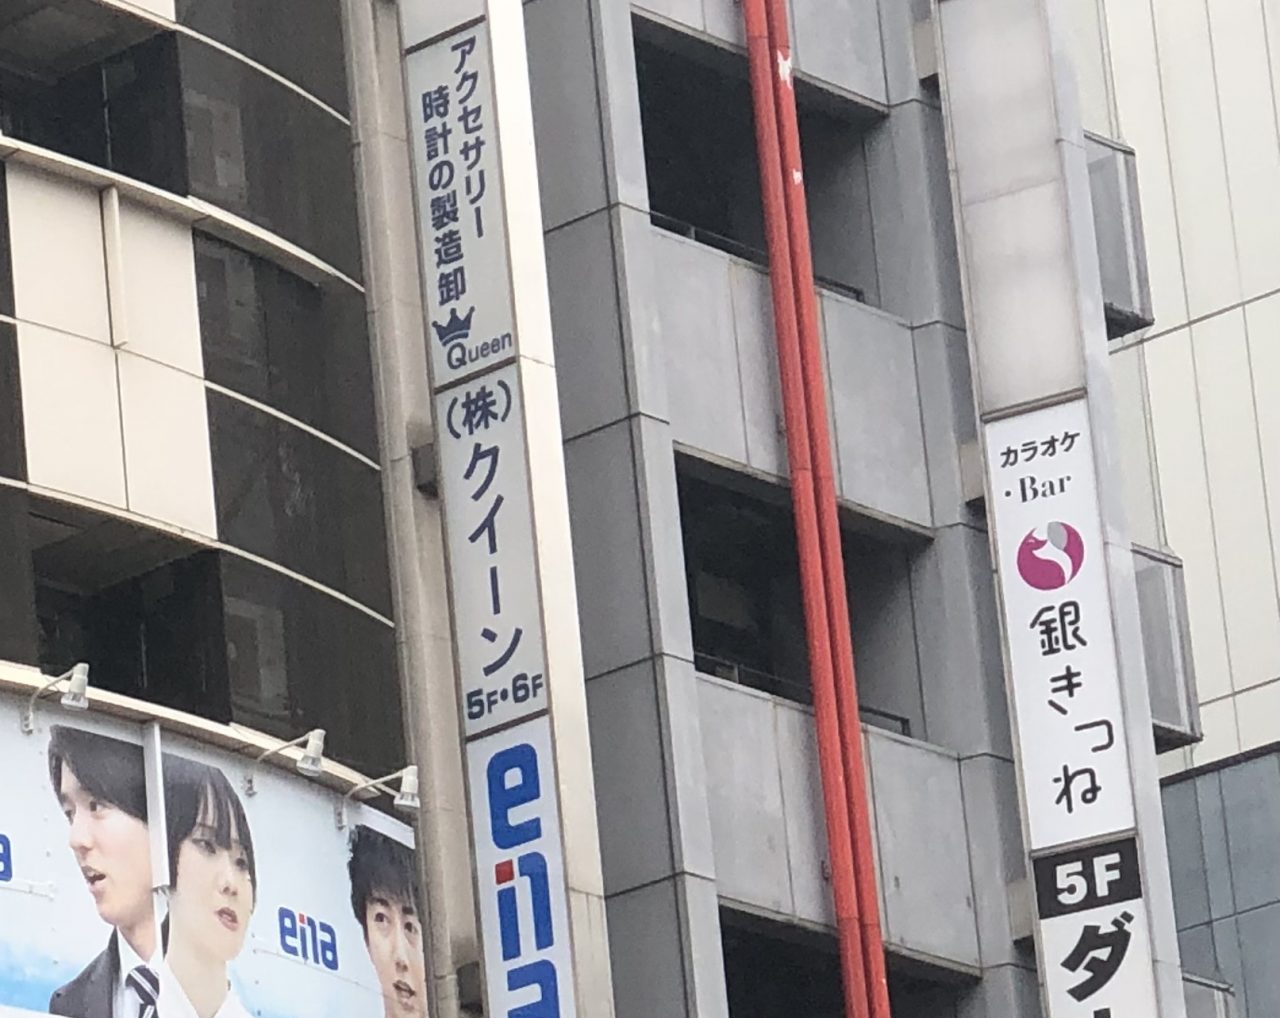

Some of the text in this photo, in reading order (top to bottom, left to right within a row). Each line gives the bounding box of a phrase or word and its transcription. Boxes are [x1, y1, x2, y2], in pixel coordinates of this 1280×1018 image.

[421, 85, 467, 306] 時計の製造卸
[451, 35, 486, 238] アクセサリー
[446, 332, 513, 370] Queen
[999, 431, 1081, 468] カラオケ
[1029, 600, 1115, 813] 銀きつね
[1055, 852, 1121, 905] 5F
